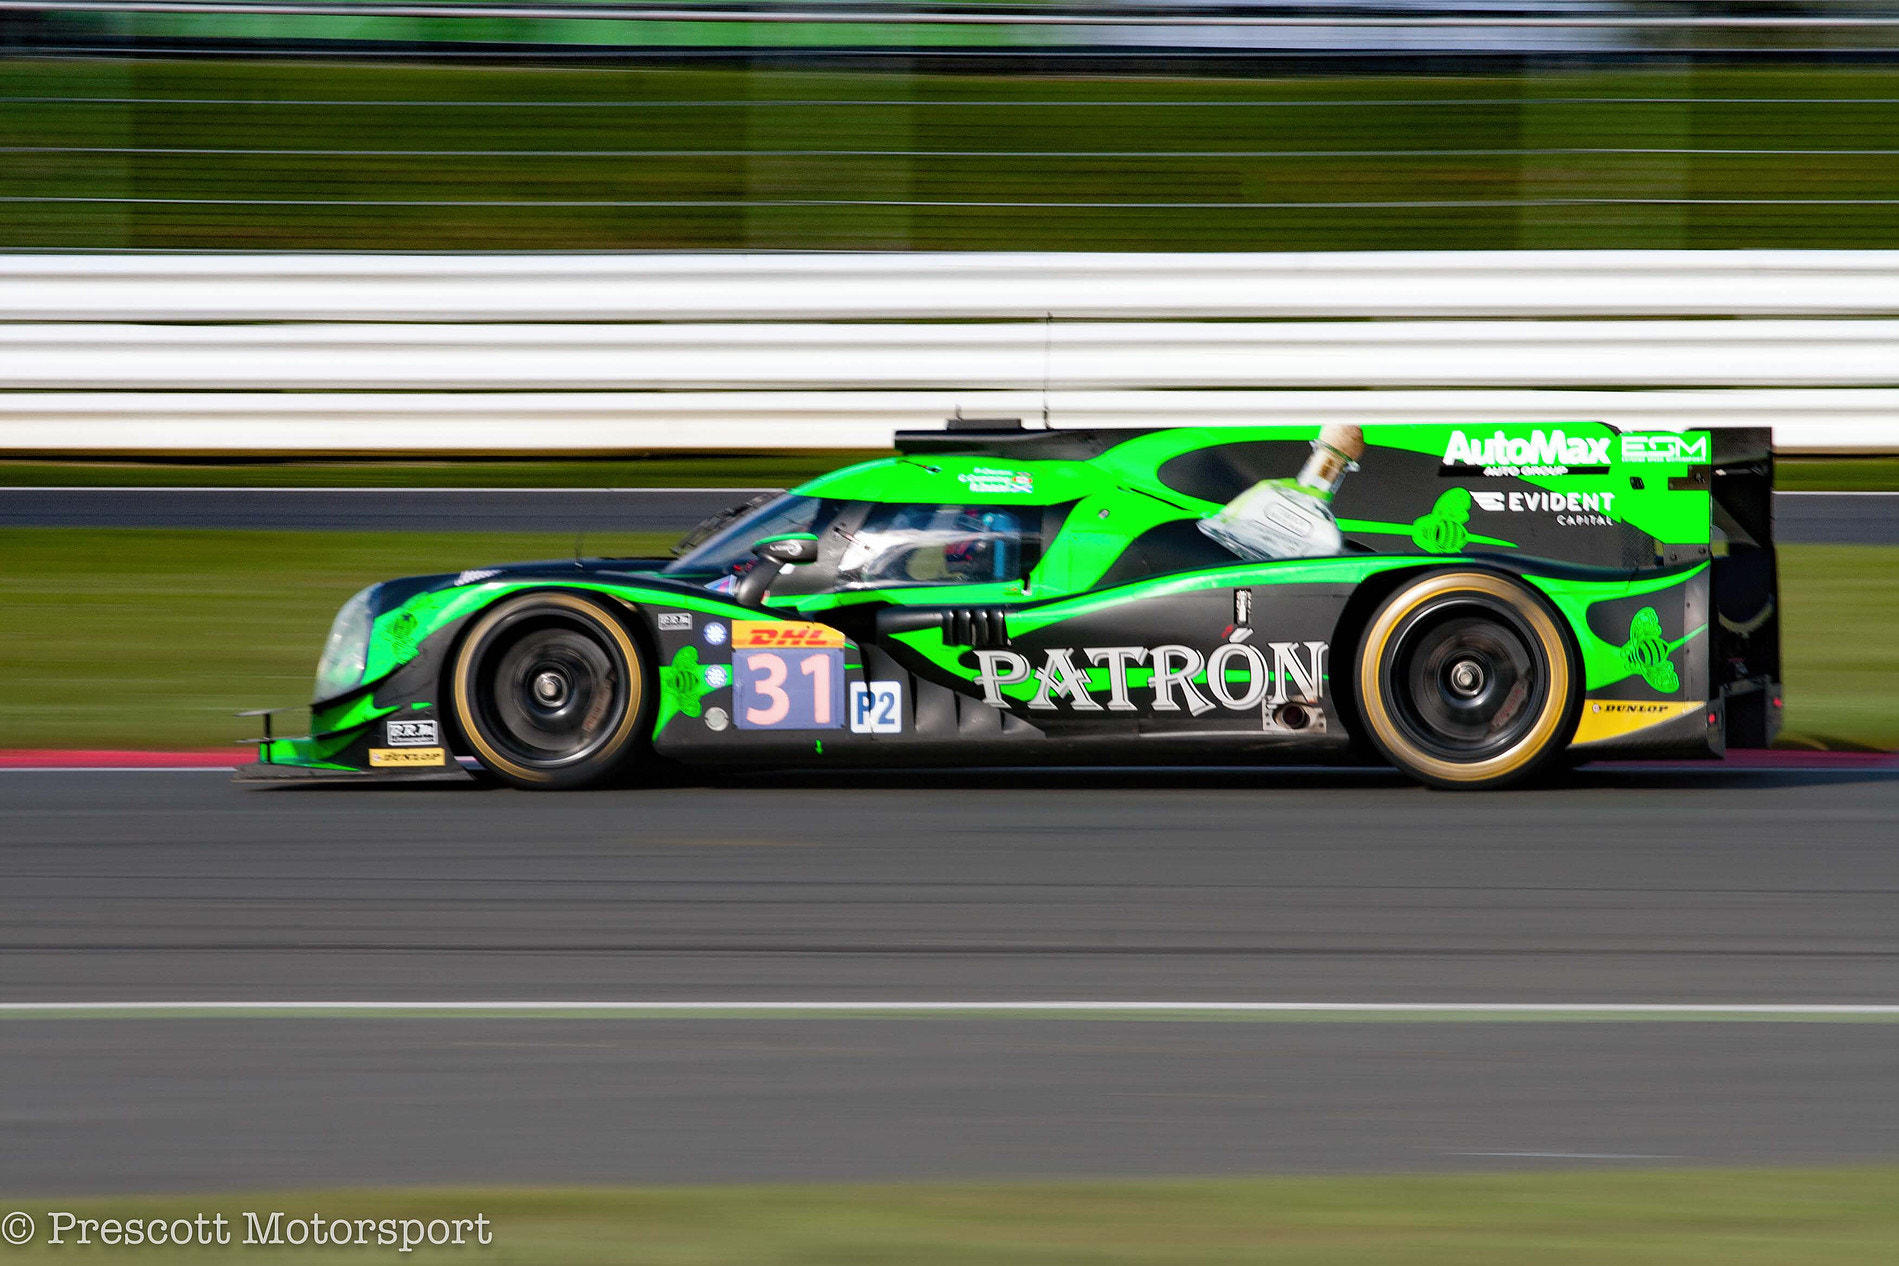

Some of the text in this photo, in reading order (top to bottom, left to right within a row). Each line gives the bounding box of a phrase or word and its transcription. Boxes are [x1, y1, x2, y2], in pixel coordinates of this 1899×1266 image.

[1442, 429, 1612, 466] AutoMax
[1621, 435, 1707, 458] ESM
[1482, 465, 1569, 477] AUTO GROUP
[1508, 492, 1616, 512] EVIDENT
[1556, 514, 1614, 526] CAPITAL
[750, 628, 828, 646] DHL
[972, 627, 1330, 718] PATRÓN
[746, 652, 831, 726] 31
[856, 690, 896, 725] P2
[1604, 704, 1669, 713] DUNLOP
